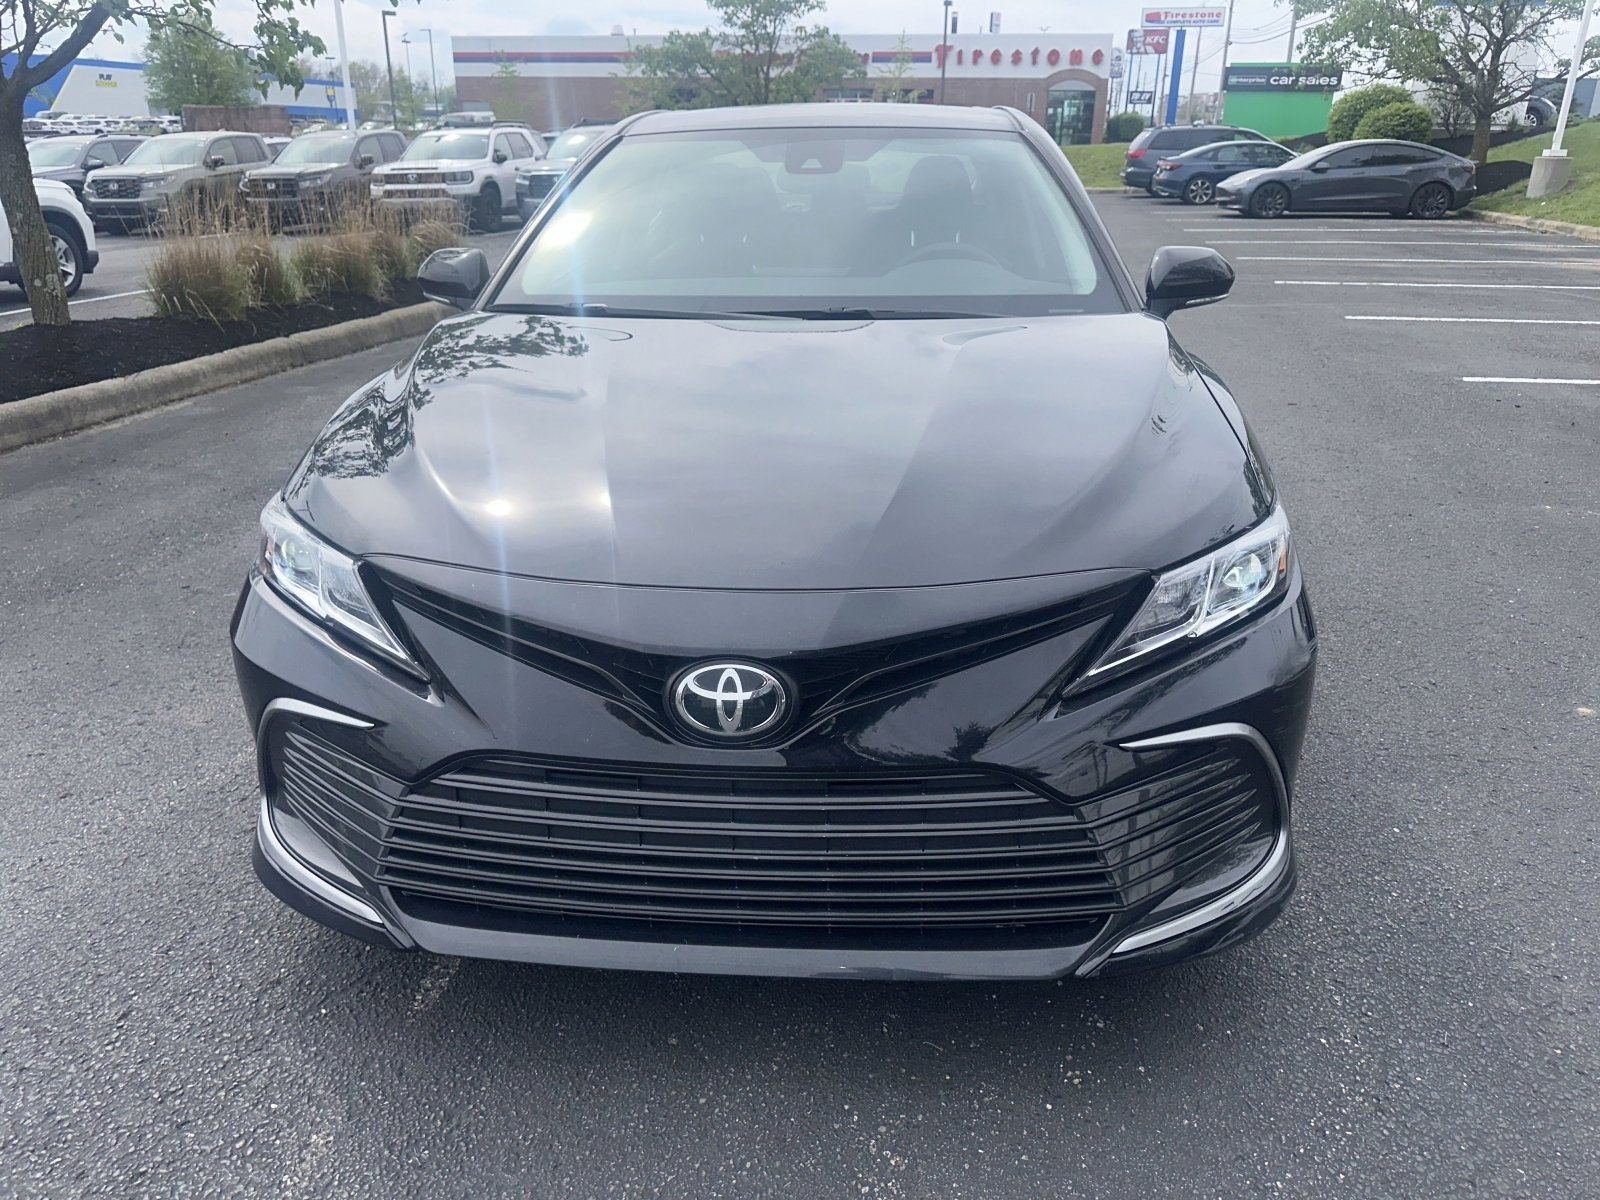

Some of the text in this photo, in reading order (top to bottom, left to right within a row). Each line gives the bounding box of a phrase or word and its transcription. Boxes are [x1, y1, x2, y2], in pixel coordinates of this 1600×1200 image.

[1163, 11, 1222, 19] Firestone
[934, 43, 1105, 69] Firestone
[1269, 76, 1296, 85] car
[1298, 75, 1338, 85] sales
